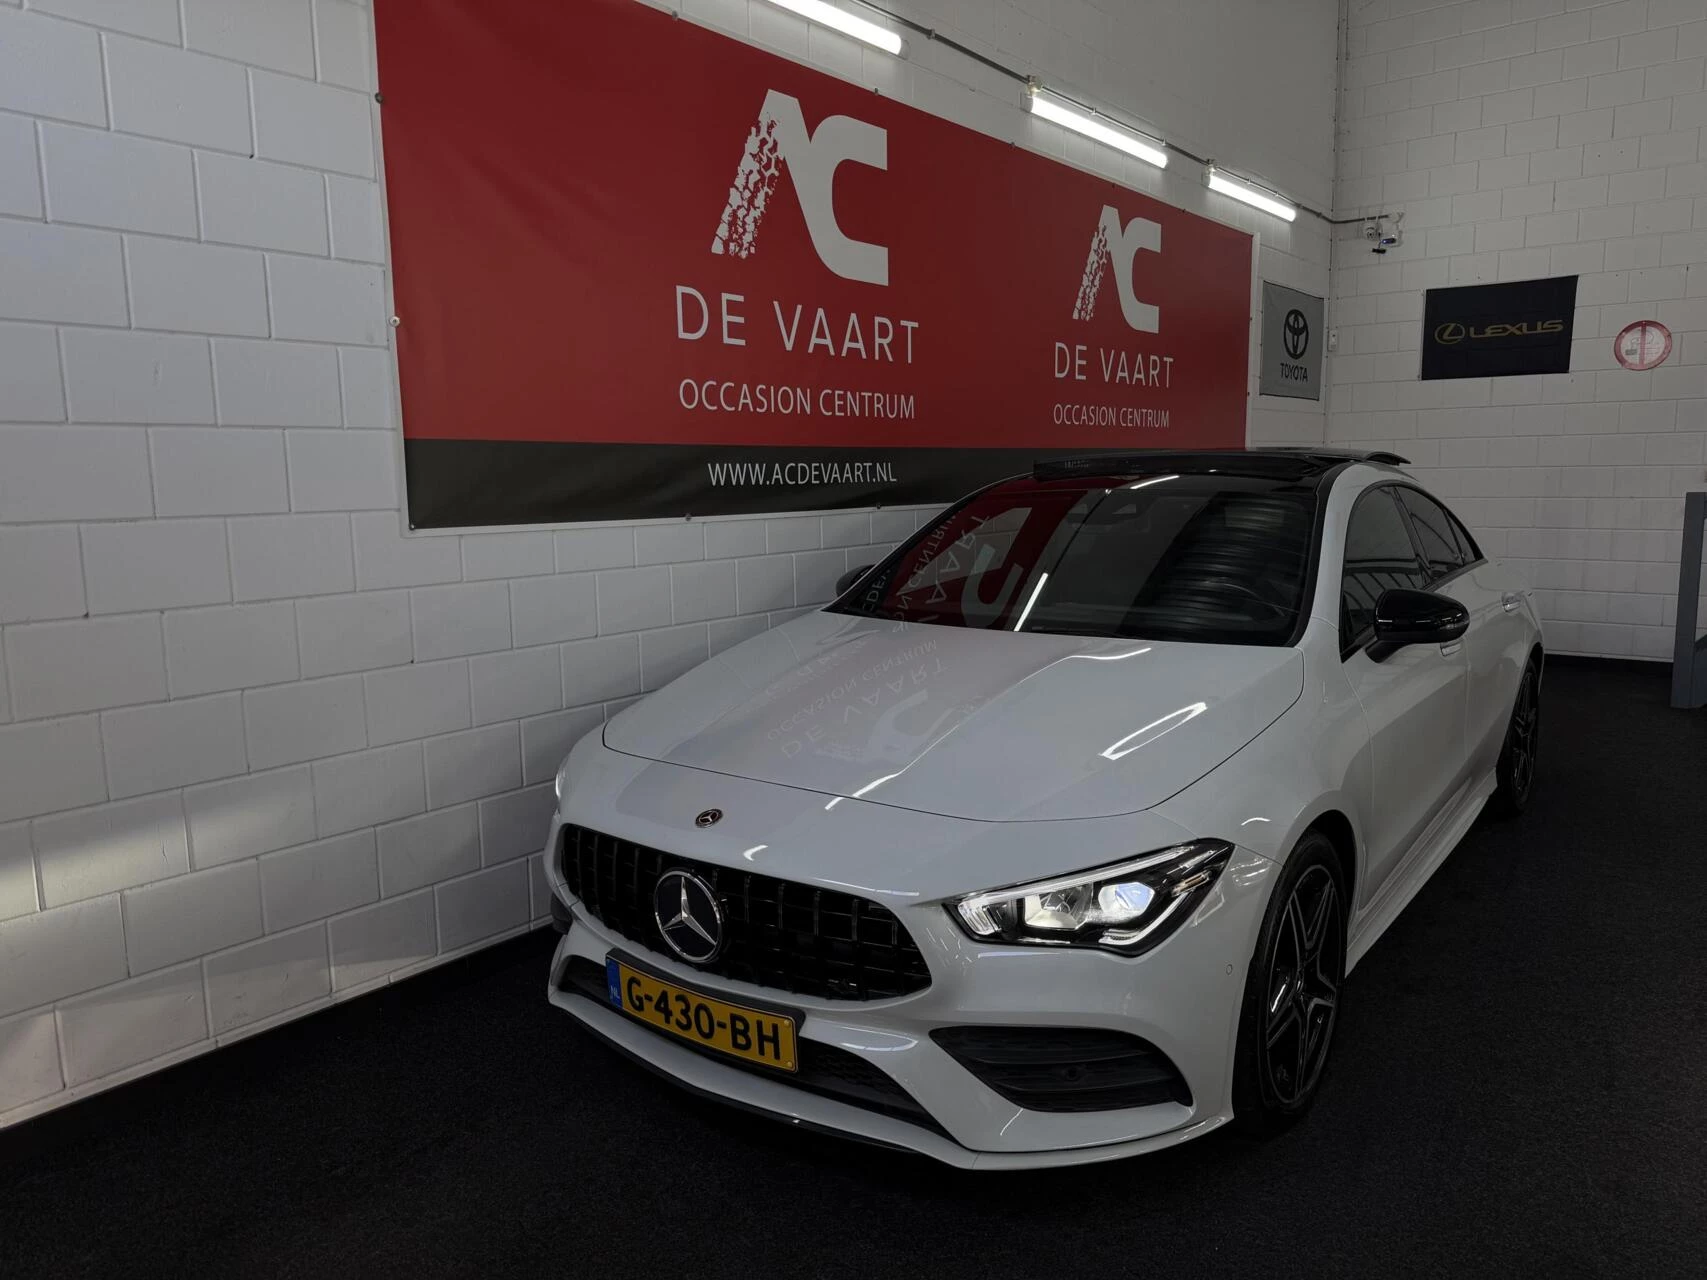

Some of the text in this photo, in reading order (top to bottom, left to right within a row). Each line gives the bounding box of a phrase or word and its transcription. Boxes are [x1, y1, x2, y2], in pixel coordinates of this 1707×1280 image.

[710, 88, 889, 286] AC
[1072, 204, 1162, 334] AC
[675, 285, 919, 364] DE VAART
[1468, 319, 1564, 339] LEXUS
[1054, 341, 1174, 389] DE VAART
[1280, 362, 1309, 383] TOYOTA
[678, 378, 915, 420] OCCASION CENTRUM
[1053, 403, 1170, 429] OCCASION CENTRUM
[707, 461, 897, 487] WWW.ACDEVAART.NL
[609, 984, 620, 999] NL
[626, 975, 781, 1061] G-430-BH
